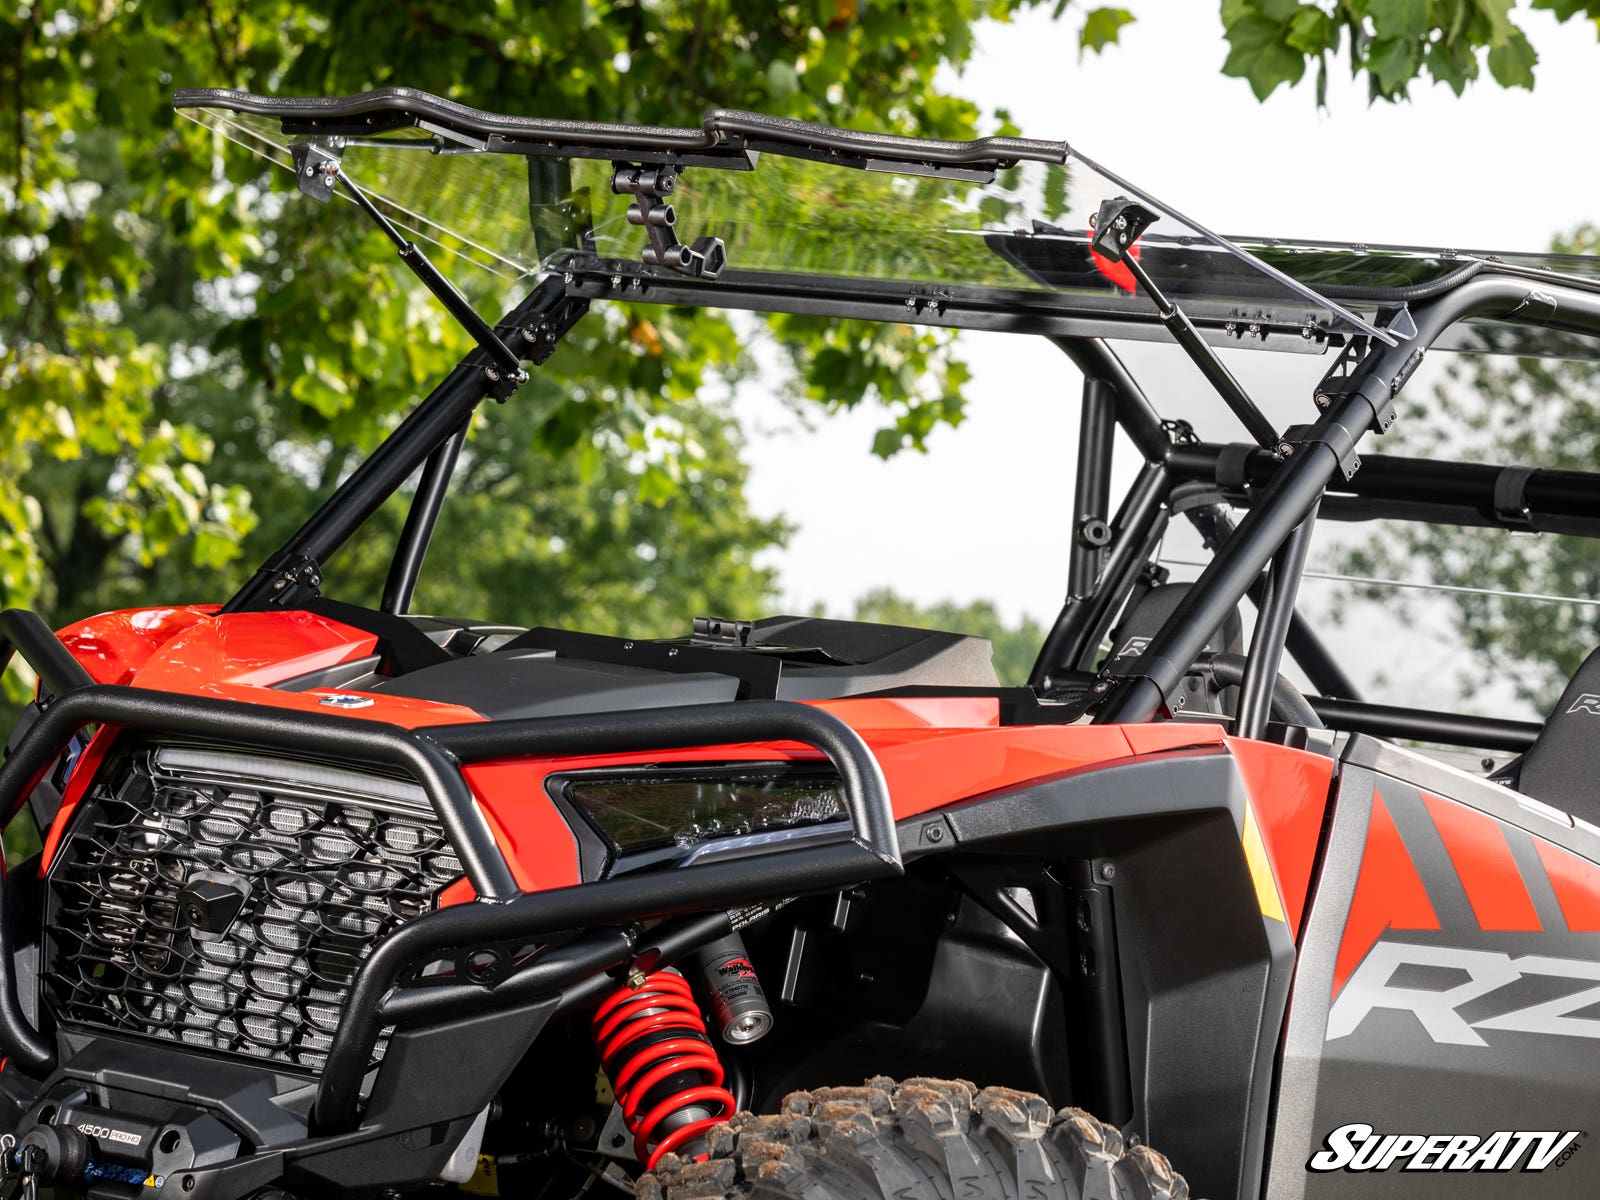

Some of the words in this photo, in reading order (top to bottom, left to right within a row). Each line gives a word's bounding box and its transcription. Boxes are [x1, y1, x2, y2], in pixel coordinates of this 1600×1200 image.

[732, 908, 770, 931] POLARIS
[77, 1123, 110, 1139] 4500
[110, 1131, 128, 1141] PRO
[127, 1135, 141, 1144] HD
